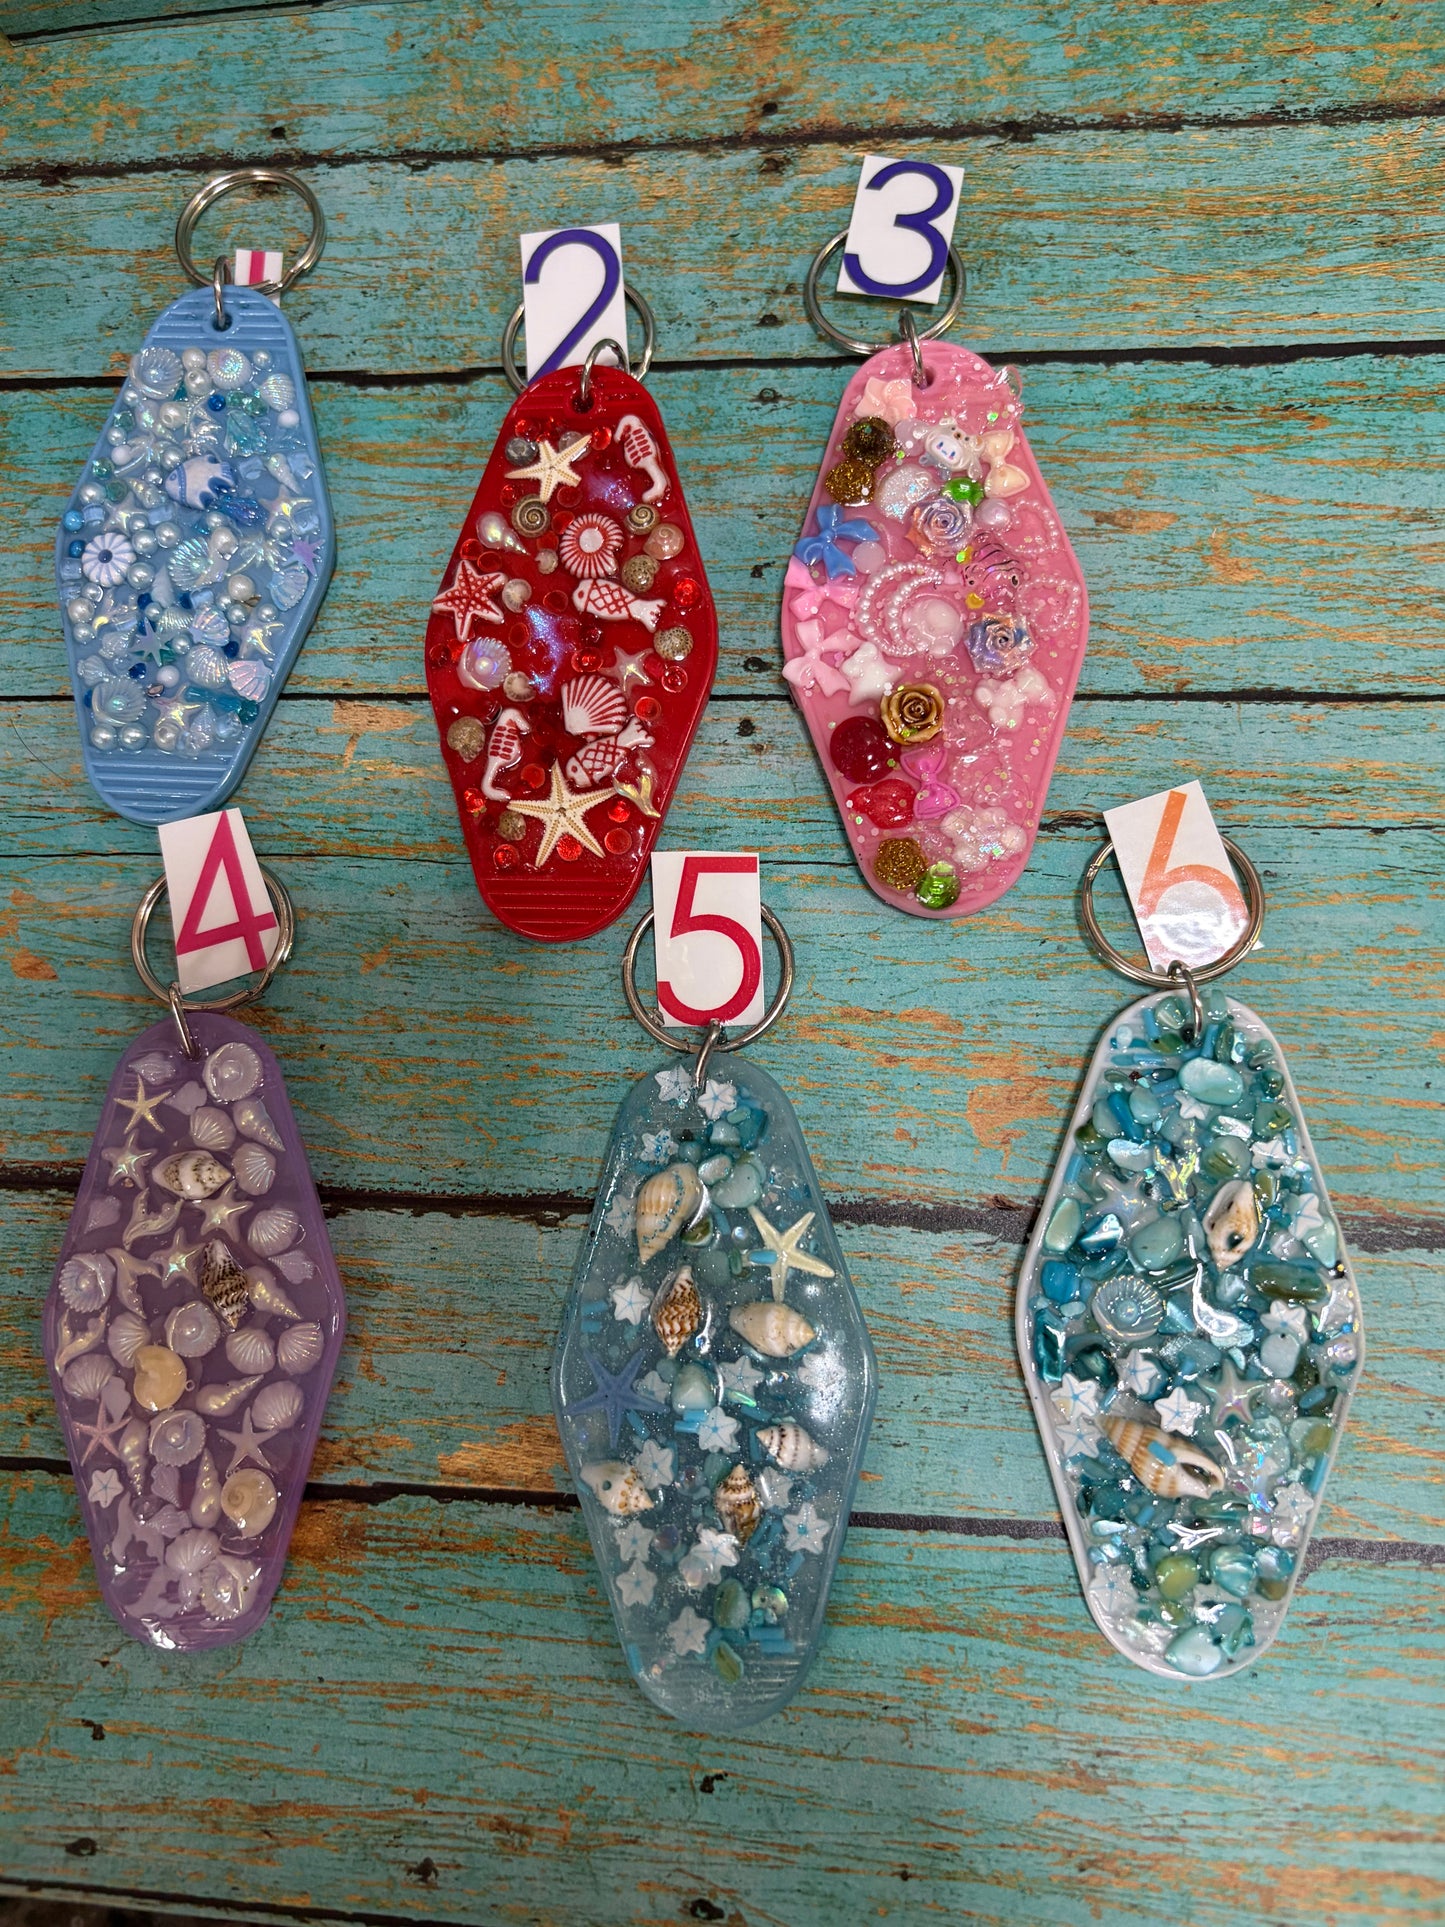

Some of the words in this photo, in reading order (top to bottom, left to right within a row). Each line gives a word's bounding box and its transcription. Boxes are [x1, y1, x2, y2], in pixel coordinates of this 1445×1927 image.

[525, 229, 620, 386] 2
[844, 161, 954, 297] 3
[177, 810, 277, 972] 4
[657, 857, 761, 1026] 5
[1137, 790, 1250, 970] 6
